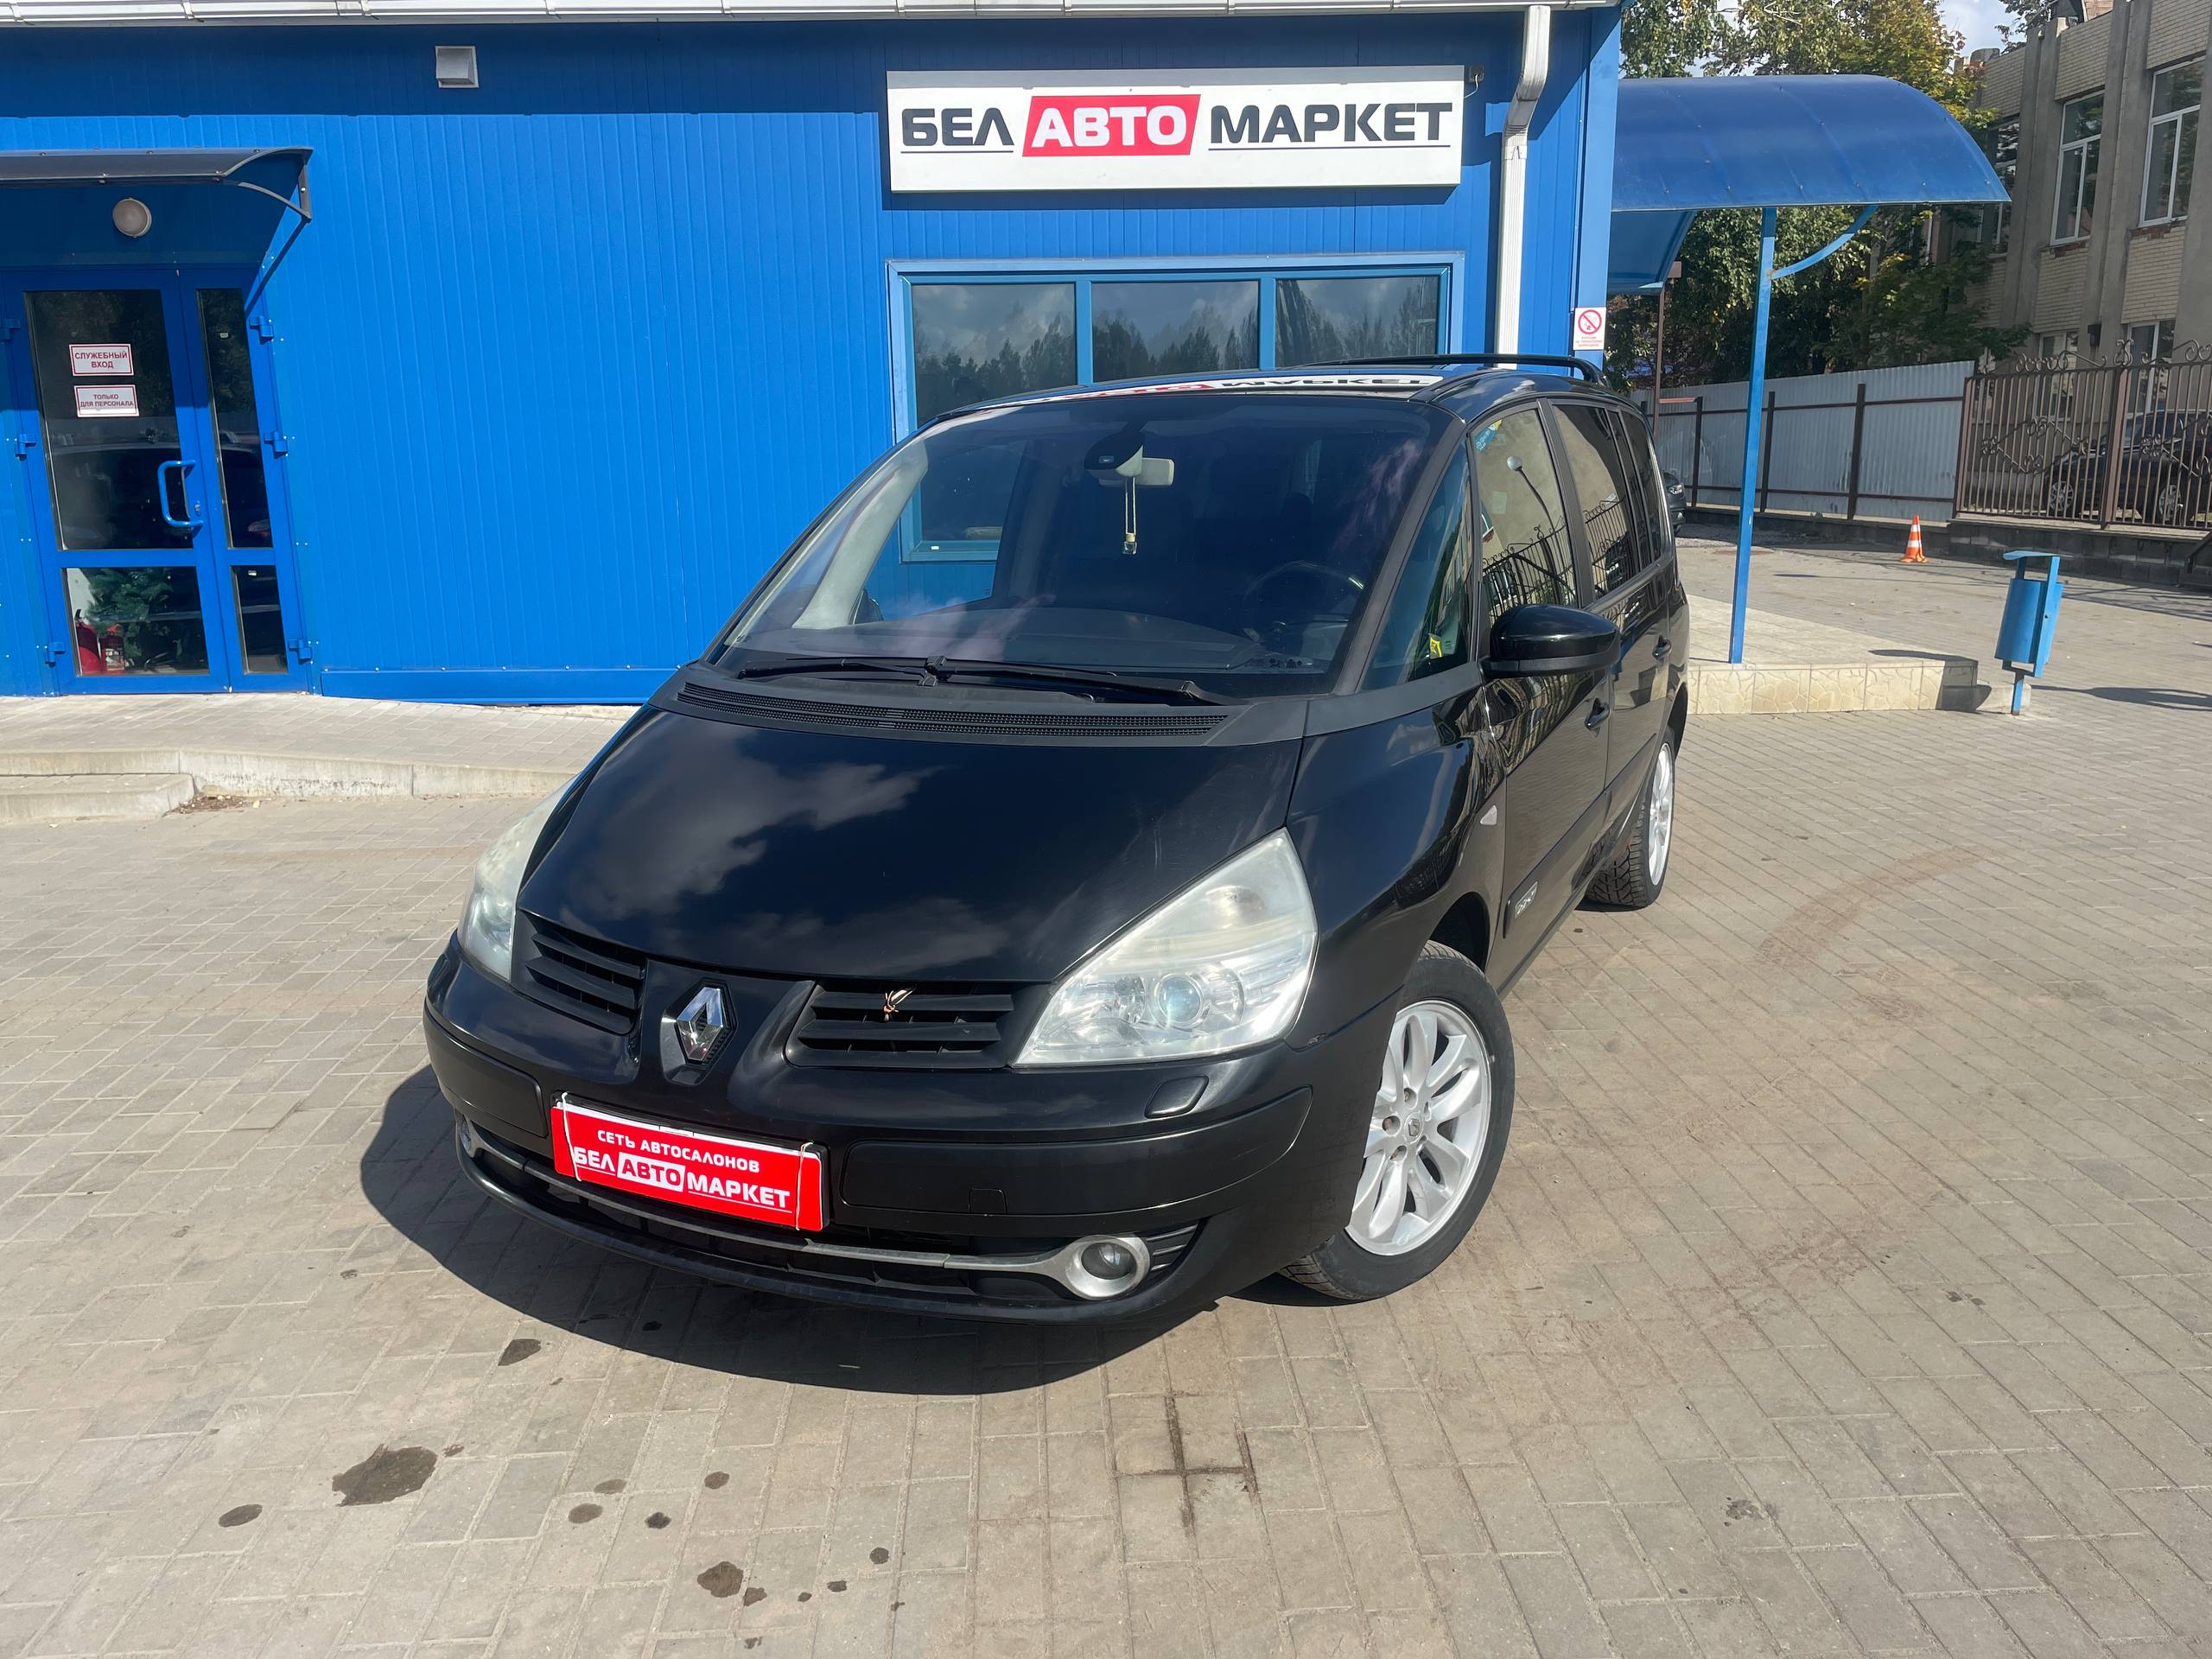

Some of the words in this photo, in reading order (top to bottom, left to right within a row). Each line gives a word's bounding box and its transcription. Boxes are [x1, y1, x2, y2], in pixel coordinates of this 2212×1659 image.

[900, 107, 1015, 147] БЕЛ
[1031, 105, 1187, 148] АВТО
[1210, 102, 1453, 144] МАРКЕТ
[74, 351, 128, 359] СЛУЖЕБНЫЙ
[91, 360, 114, 369] ВХОД
[597, 1129, 636, 1149] СЕТЬ
[640, 1141, 760, 1173] АВТОСАЛОНОВ
[574, 1146, 616, 1173] БЕЛ
[621, 1158, 682, 1187] АВТО
[687, 1172, 791, 1209] МАРКЕТ
